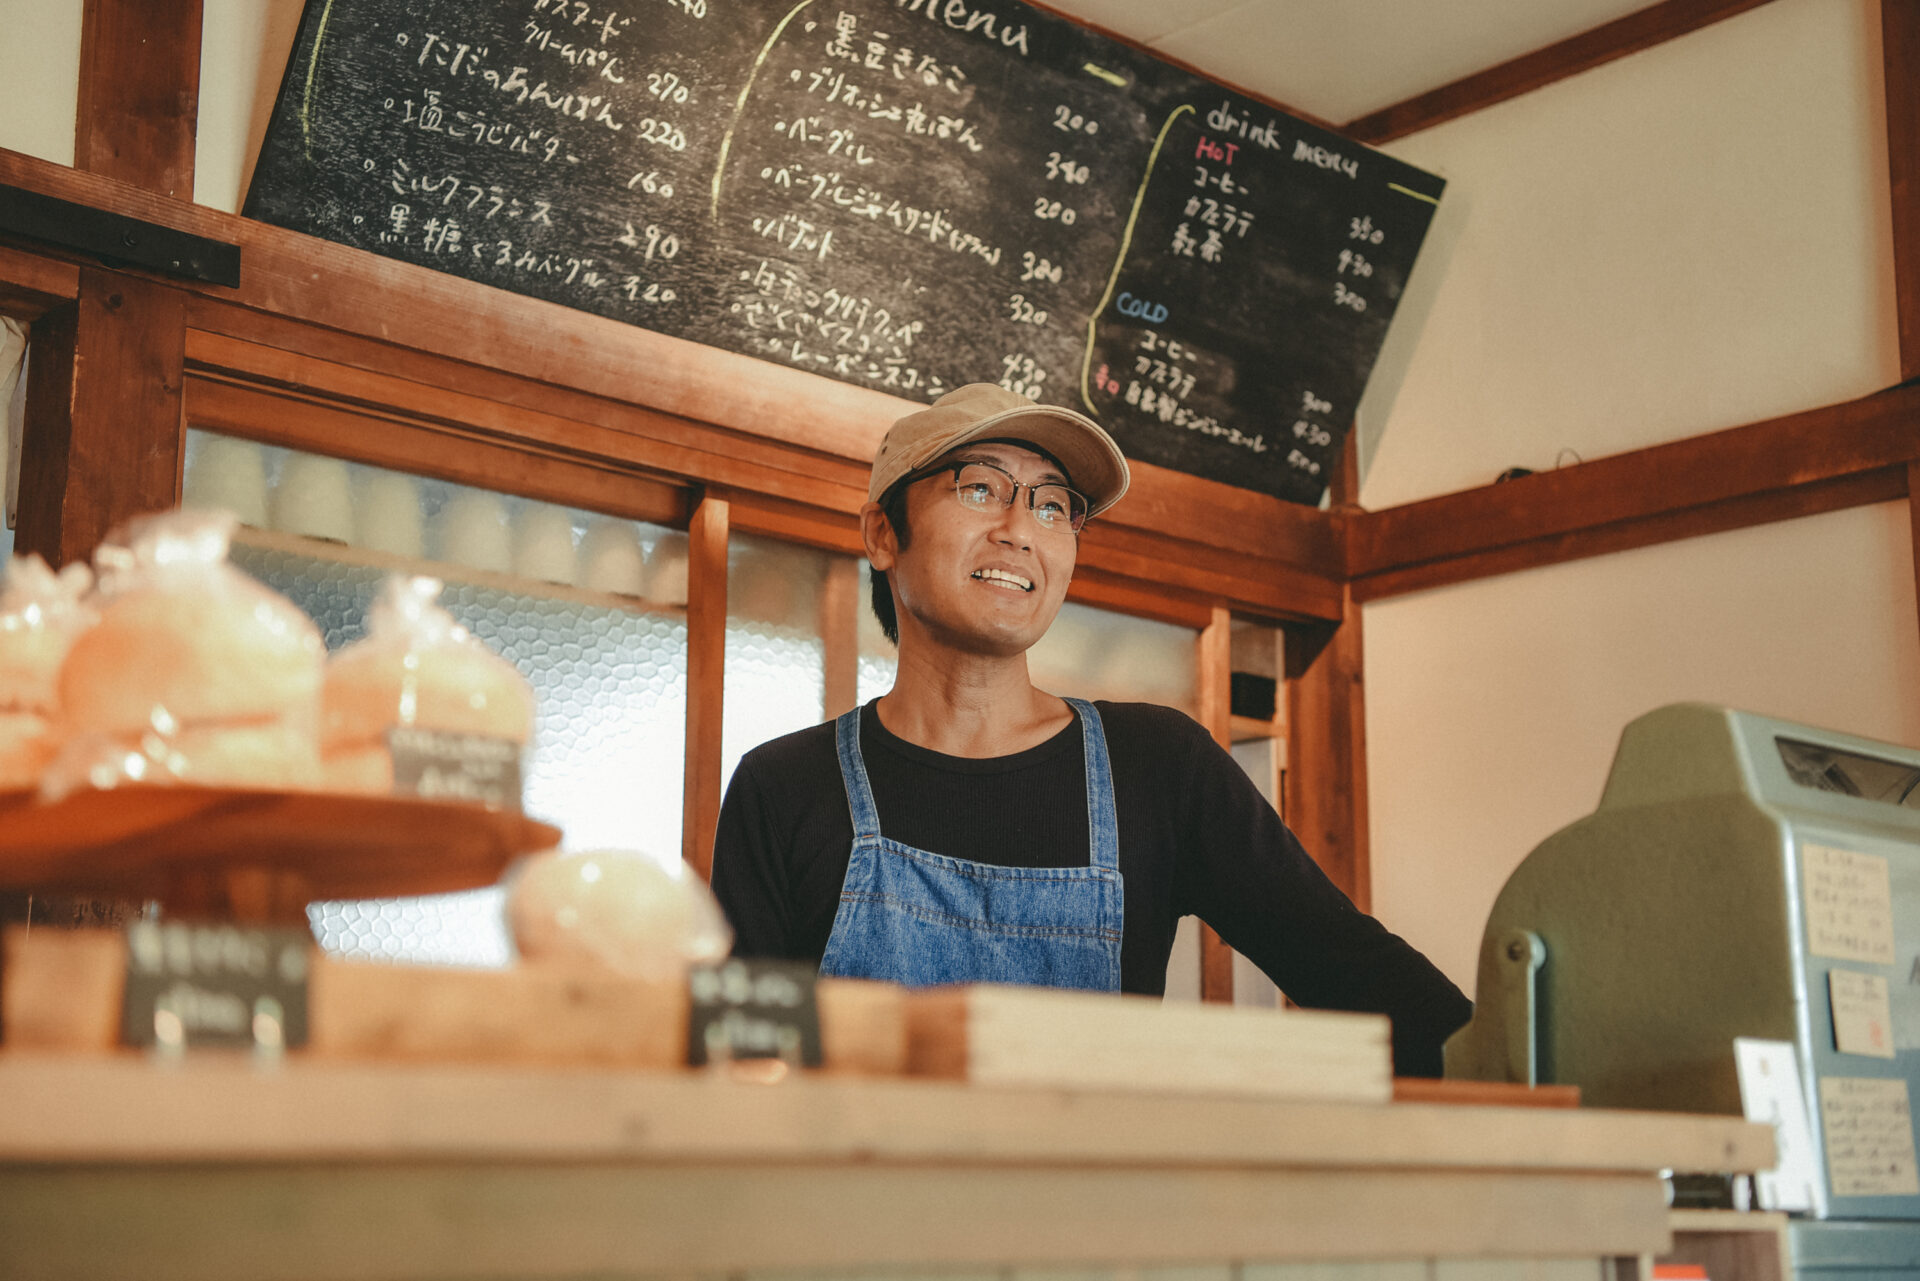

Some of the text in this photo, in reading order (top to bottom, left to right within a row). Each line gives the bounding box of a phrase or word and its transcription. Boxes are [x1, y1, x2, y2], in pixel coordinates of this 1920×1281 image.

[418, 31, 686, 151] ただのあんぱん 220
[647, 72, 689, 103] 270
[1053, 104, 1099, 135] 200
[1206, 100, 1360, 180] drink menu
[391, 158, 551, 227] ミルクフランス
[628, 172, 674, 198] 160
[1193, 165, 1249, 194] コーヒー
[1009, 294, 1048, 325] 320
[1115, 291, 1169, 323] COLD
[1140, 328, 1197, 362] コーヒー
[1002, 353, 1046, 384] 430
